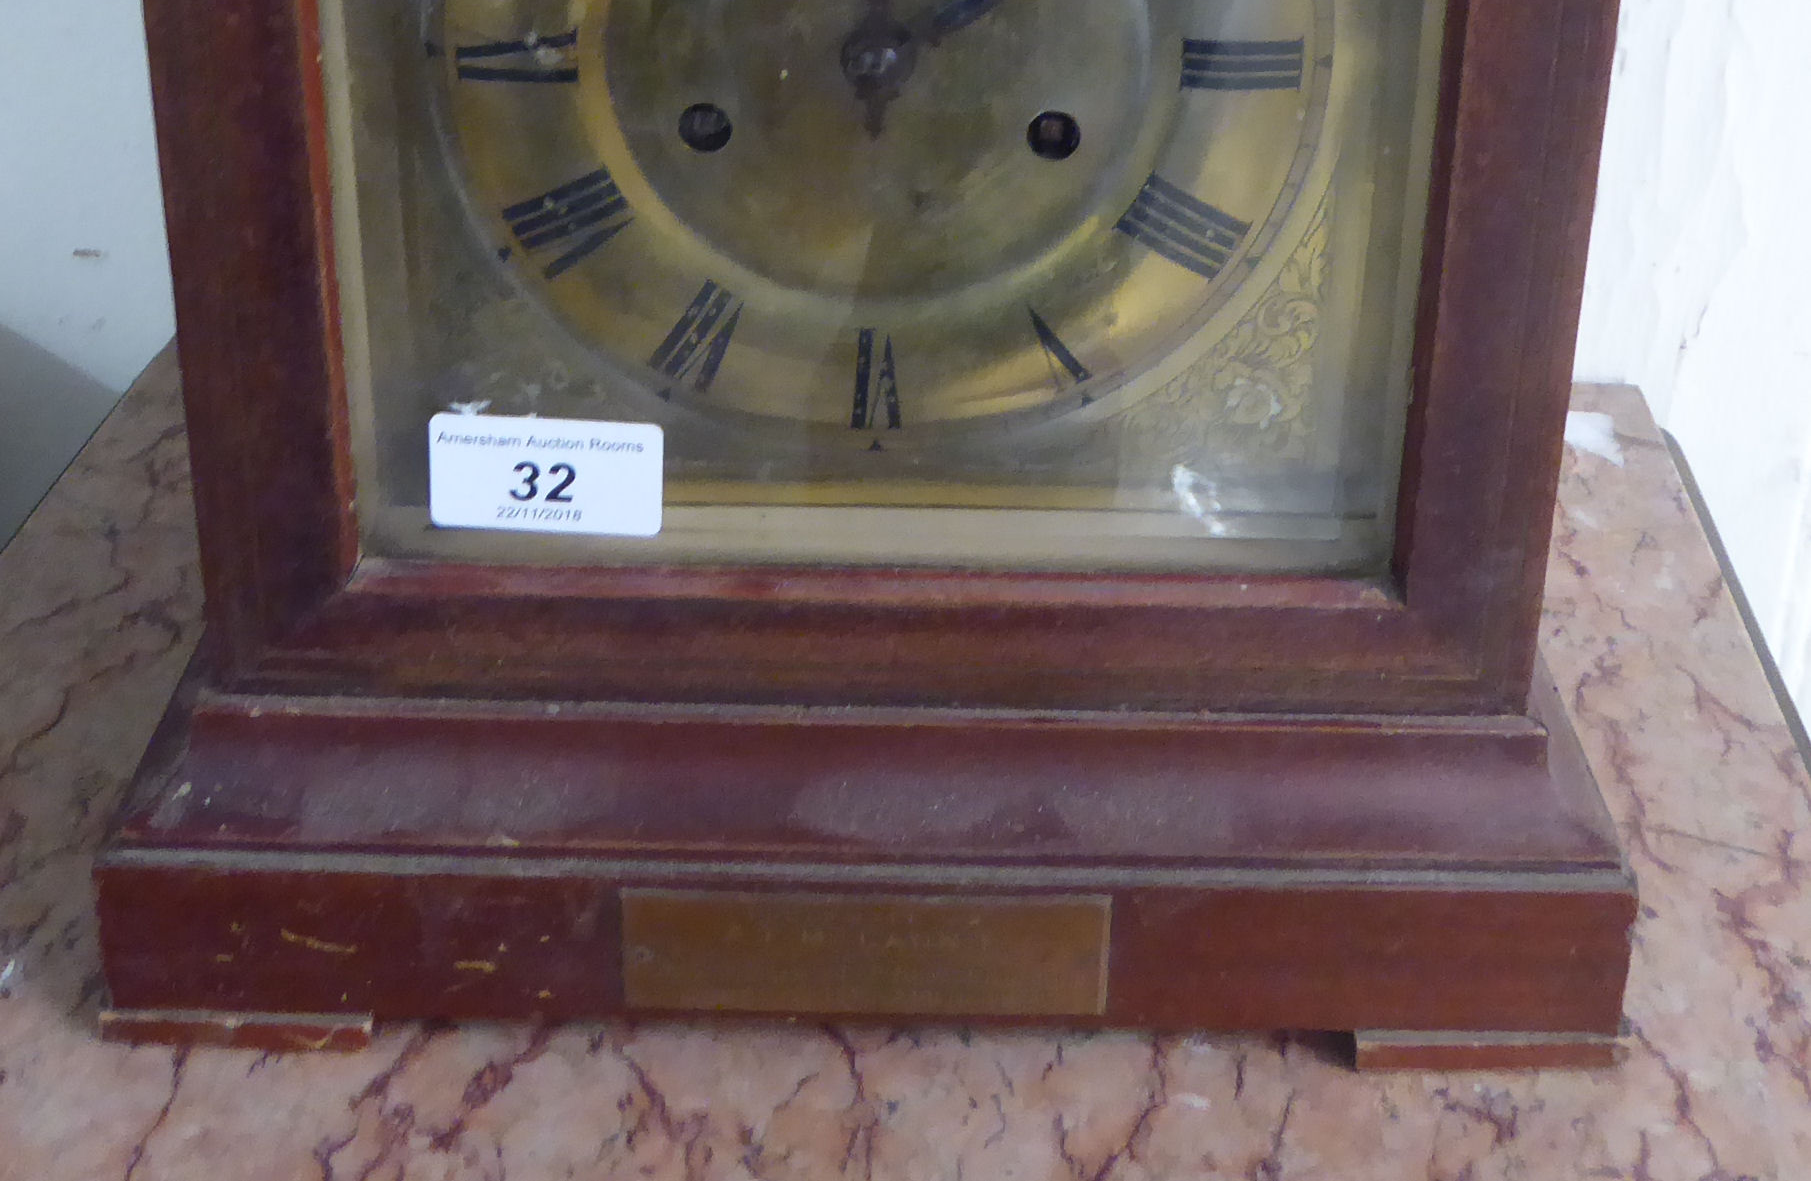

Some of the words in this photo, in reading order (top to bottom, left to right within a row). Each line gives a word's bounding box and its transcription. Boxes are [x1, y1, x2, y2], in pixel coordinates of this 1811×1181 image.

[1180, 36, 1304, 91] III
[502, 162, 635, 280] VIII
[1112, 170, 1253, 281] IIII
[648, 279, 745, 392] VII
[850, 327, 902, 430] VI
[1026, 304, 1092, 390] V
[436, 431, 522, 449] Amersham
[525, 434, 585, 451] Auction
[588, 438, 645, 453] Rooms
[509, 460, 577, 503] 32
[496, 506, 583, 522] 22/11/2018
